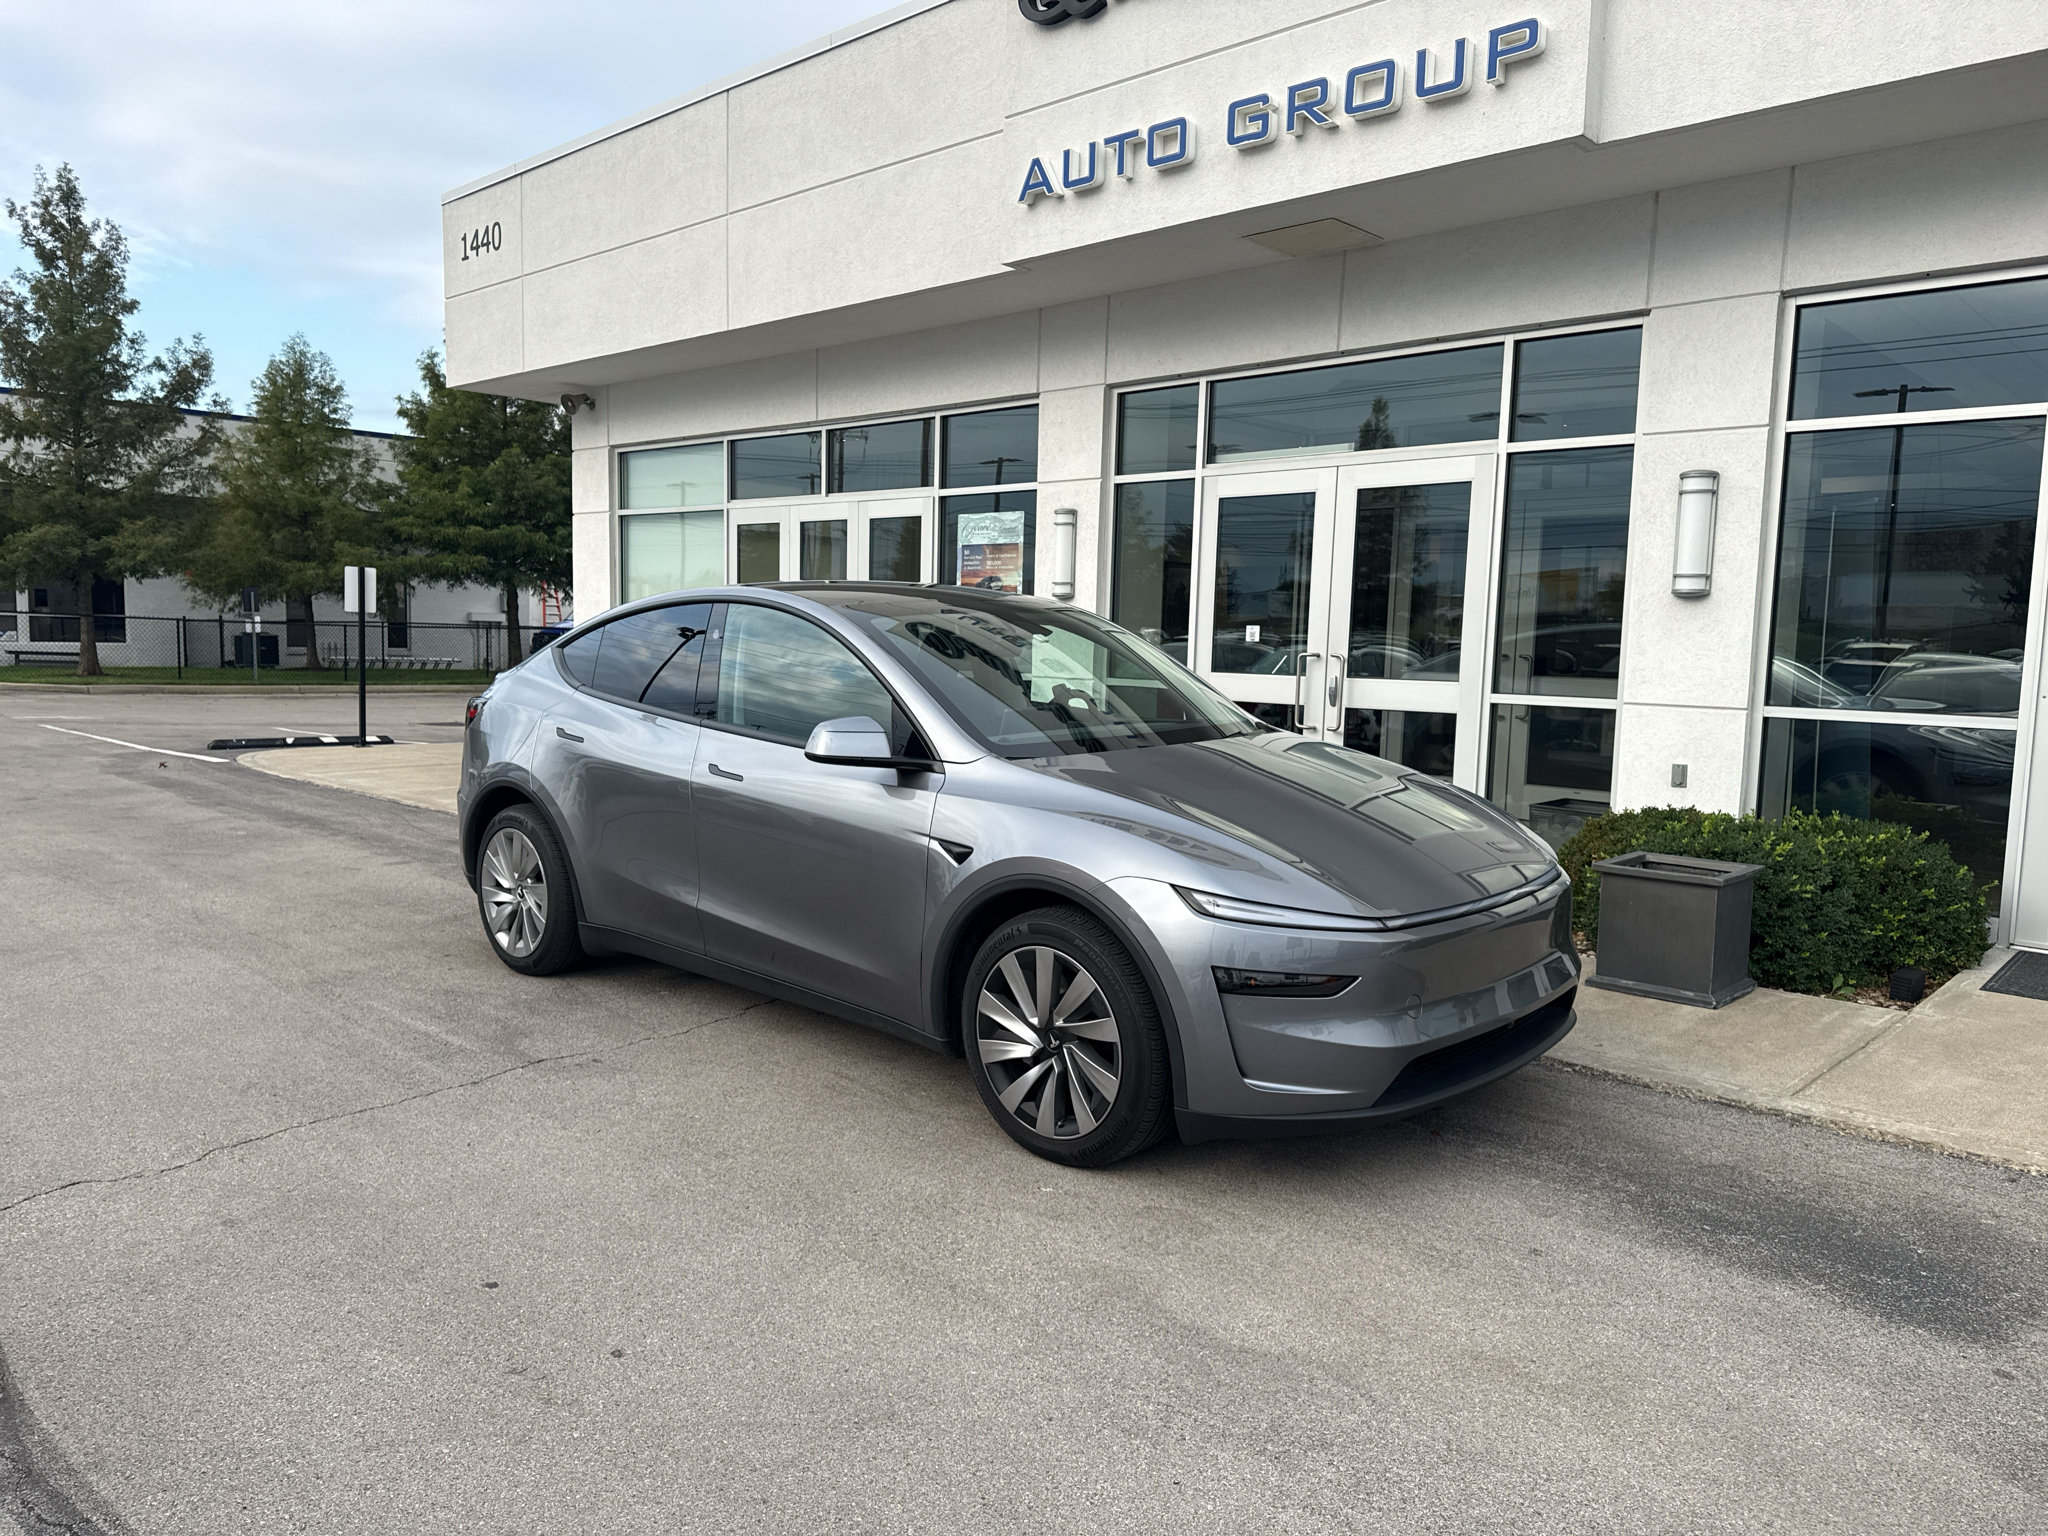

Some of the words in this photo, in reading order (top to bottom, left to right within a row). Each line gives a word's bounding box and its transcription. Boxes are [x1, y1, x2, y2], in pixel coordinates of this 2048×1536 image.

[1018, 116, 1192, 204] AUTO
[1226, 17, 1546, 150] GROUP
[461, 221, 501, 261] 1440
[975, 928, 1016, 976] Continental
